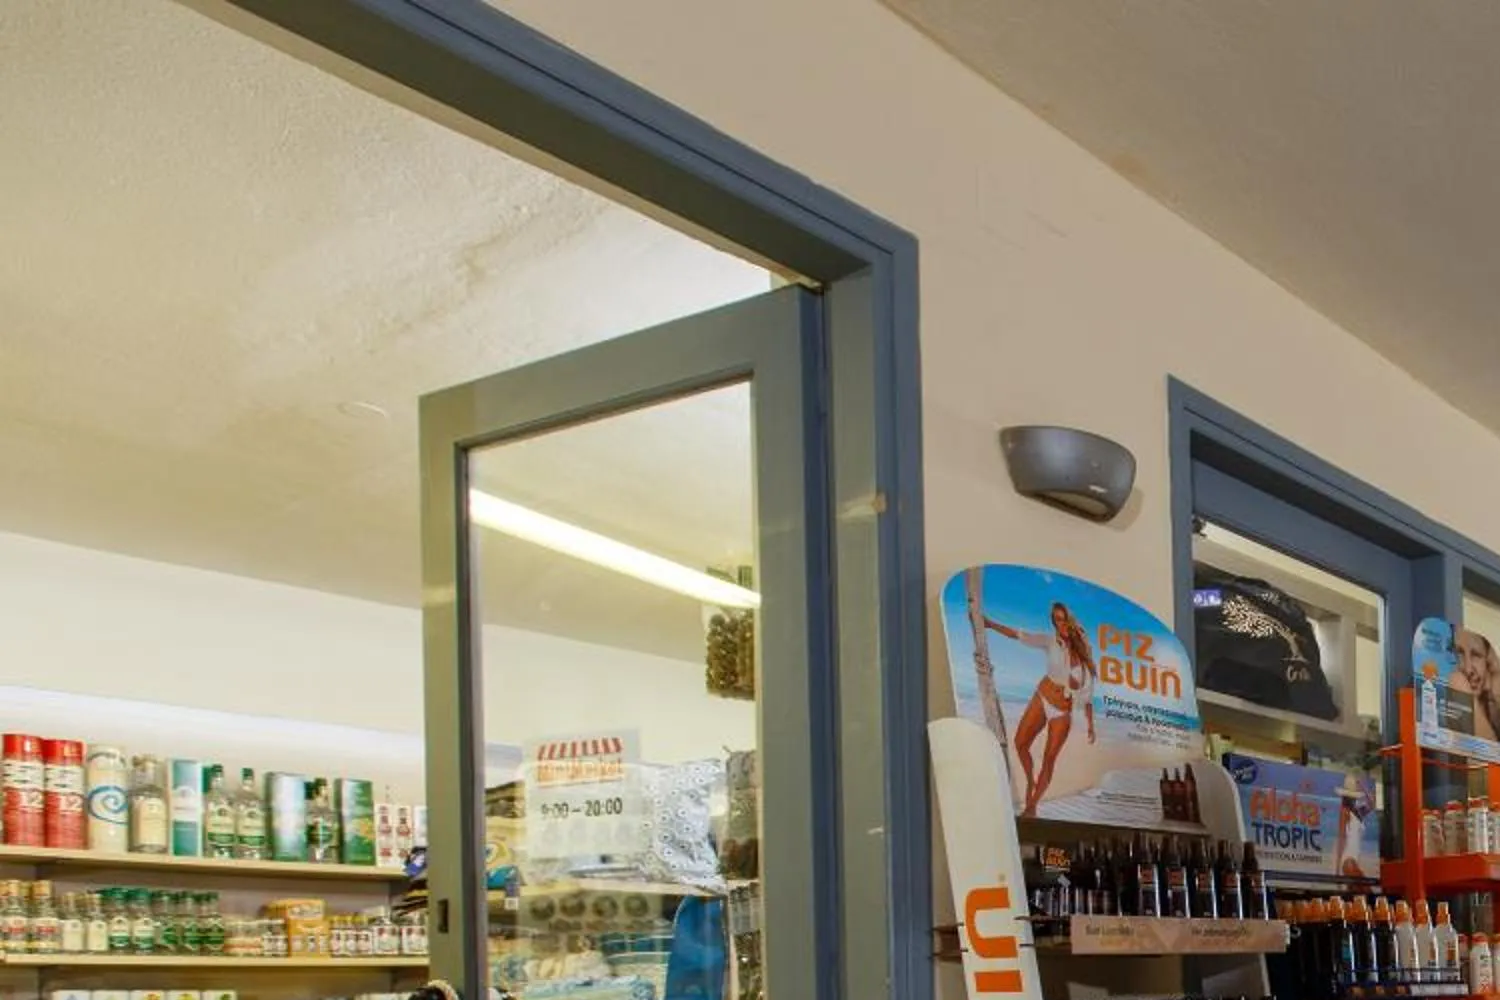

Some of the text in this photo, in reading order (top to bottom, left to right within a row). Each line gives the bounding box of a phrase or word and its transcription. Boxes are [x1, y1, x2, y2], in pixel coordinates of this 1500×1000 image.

[1097, 622, 1155, 662] PIZ
[584, 797, 624, 817] 20:00
[1250, 785, 1321, 826] Aloha
[1251, 821, 1323, 852] TROPIC
